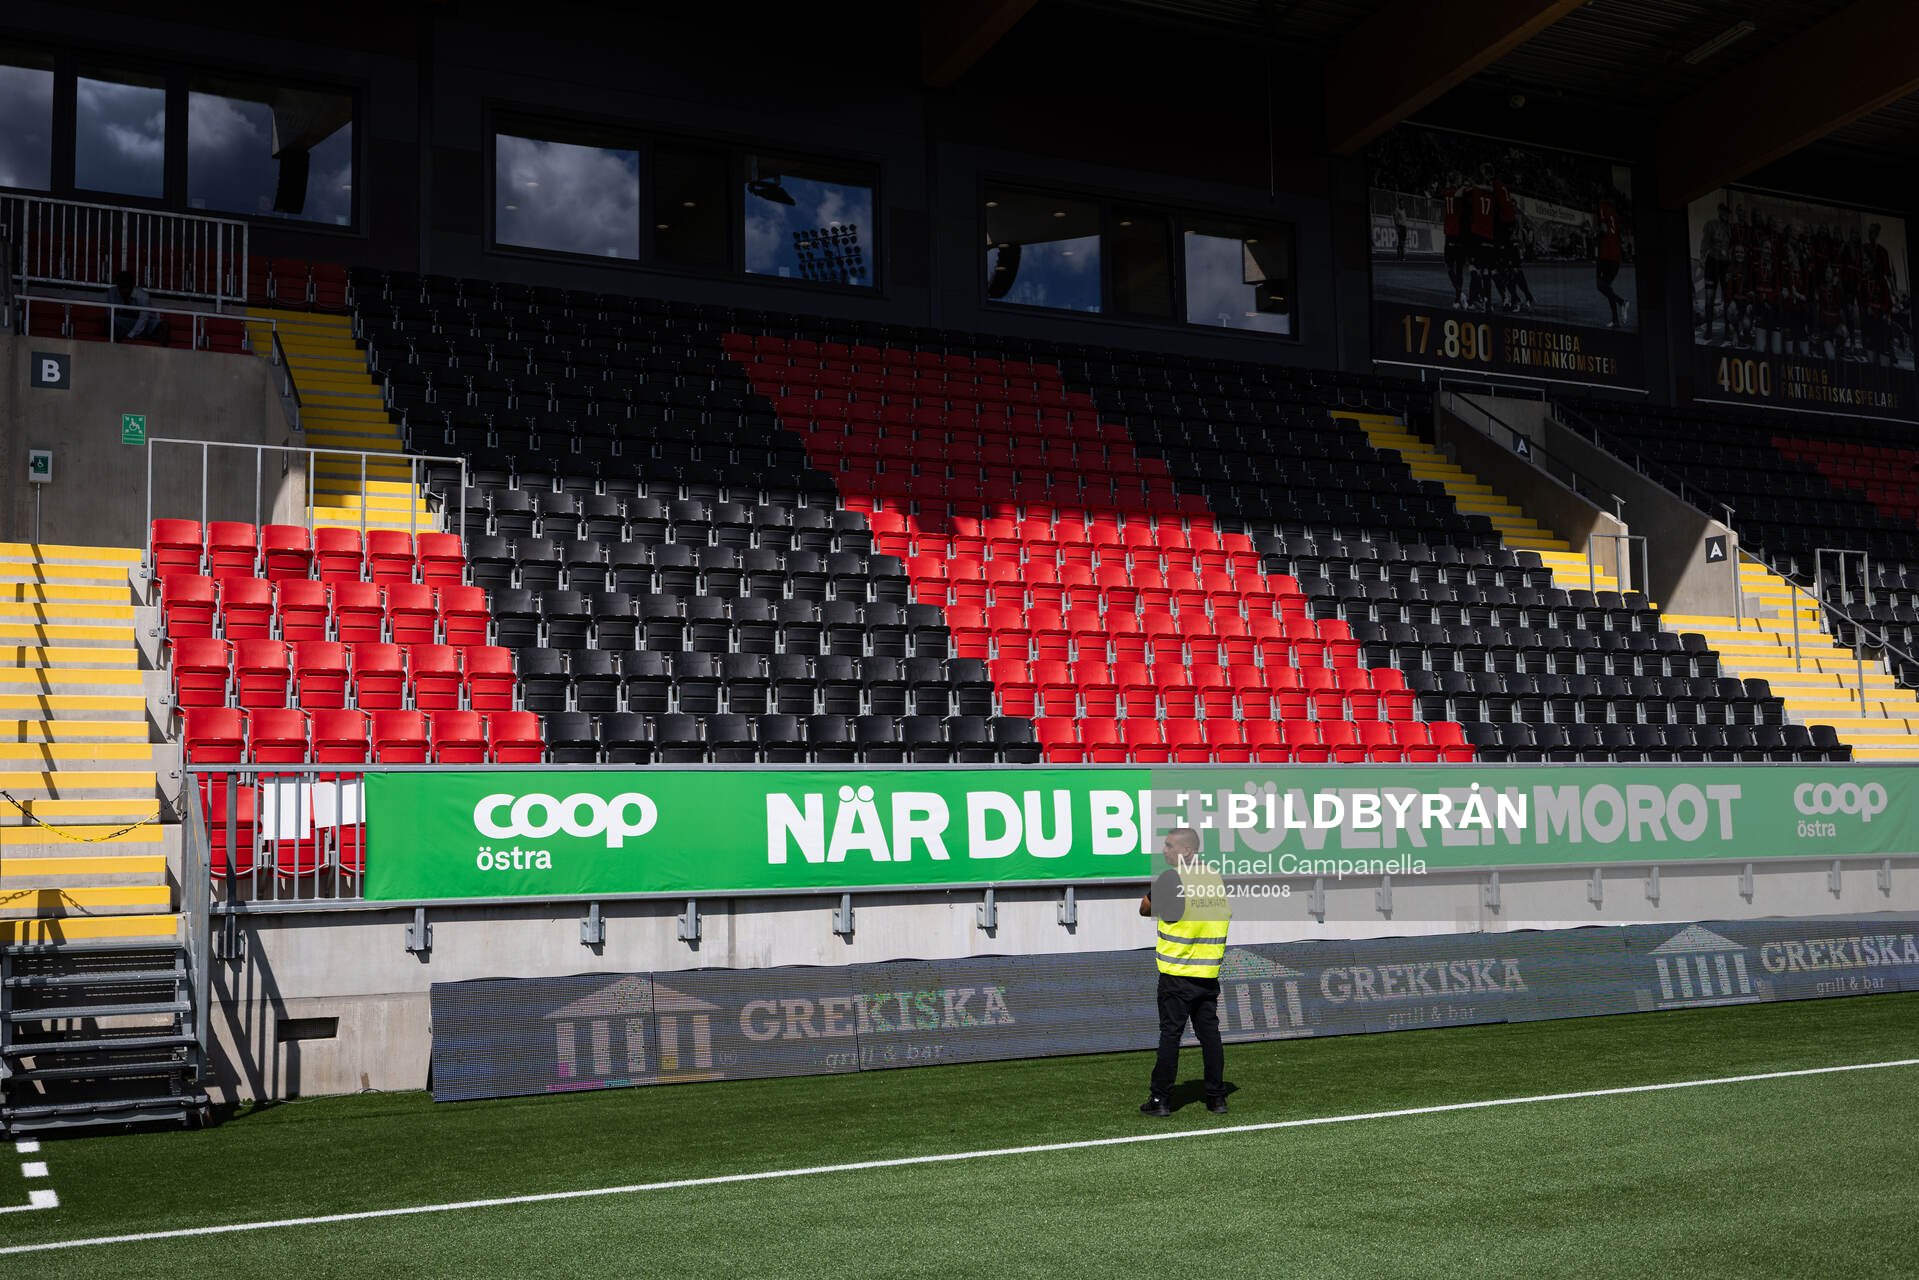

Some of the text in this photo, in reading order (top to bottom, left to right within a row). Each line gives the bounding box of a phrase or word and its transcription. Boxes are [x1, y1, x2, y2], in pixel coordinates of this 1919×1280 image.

[1402, 314, 1493, 363] 17.890
[1504, 327, 1581, 353] SPORTSLIGA
[41, 359, 61, 382] B
[1504, 346, 1617, 376] SAMMANKOMSTER
[1717, 356, 1770, 397] 4000
[1517, 438, 1529, 454] A
[1709, 541, 1723, 558] A
[1794, 783, 1888, 822] coop
[473, 792, 658, 848] coop
[766, 785, 950, 864] NÄR
[966, 790, 1073, 859] DU
[1533, 783, 1742, 844] MOROT
[1797, 820, 1836, 837] östra
[476, 846, 552, 871] östra
[1761, 935, 1919, 972] GREKISKA
[1320, 958, 1528, 1003] GREKISKA
[1816, 976, 1885, 995] grill & bar
[739, 986, 1015, 1040] GREKISKA
[1389, 1004, 1476, 1028] grill & bar
[907, 1044, 944, 1059] bar
